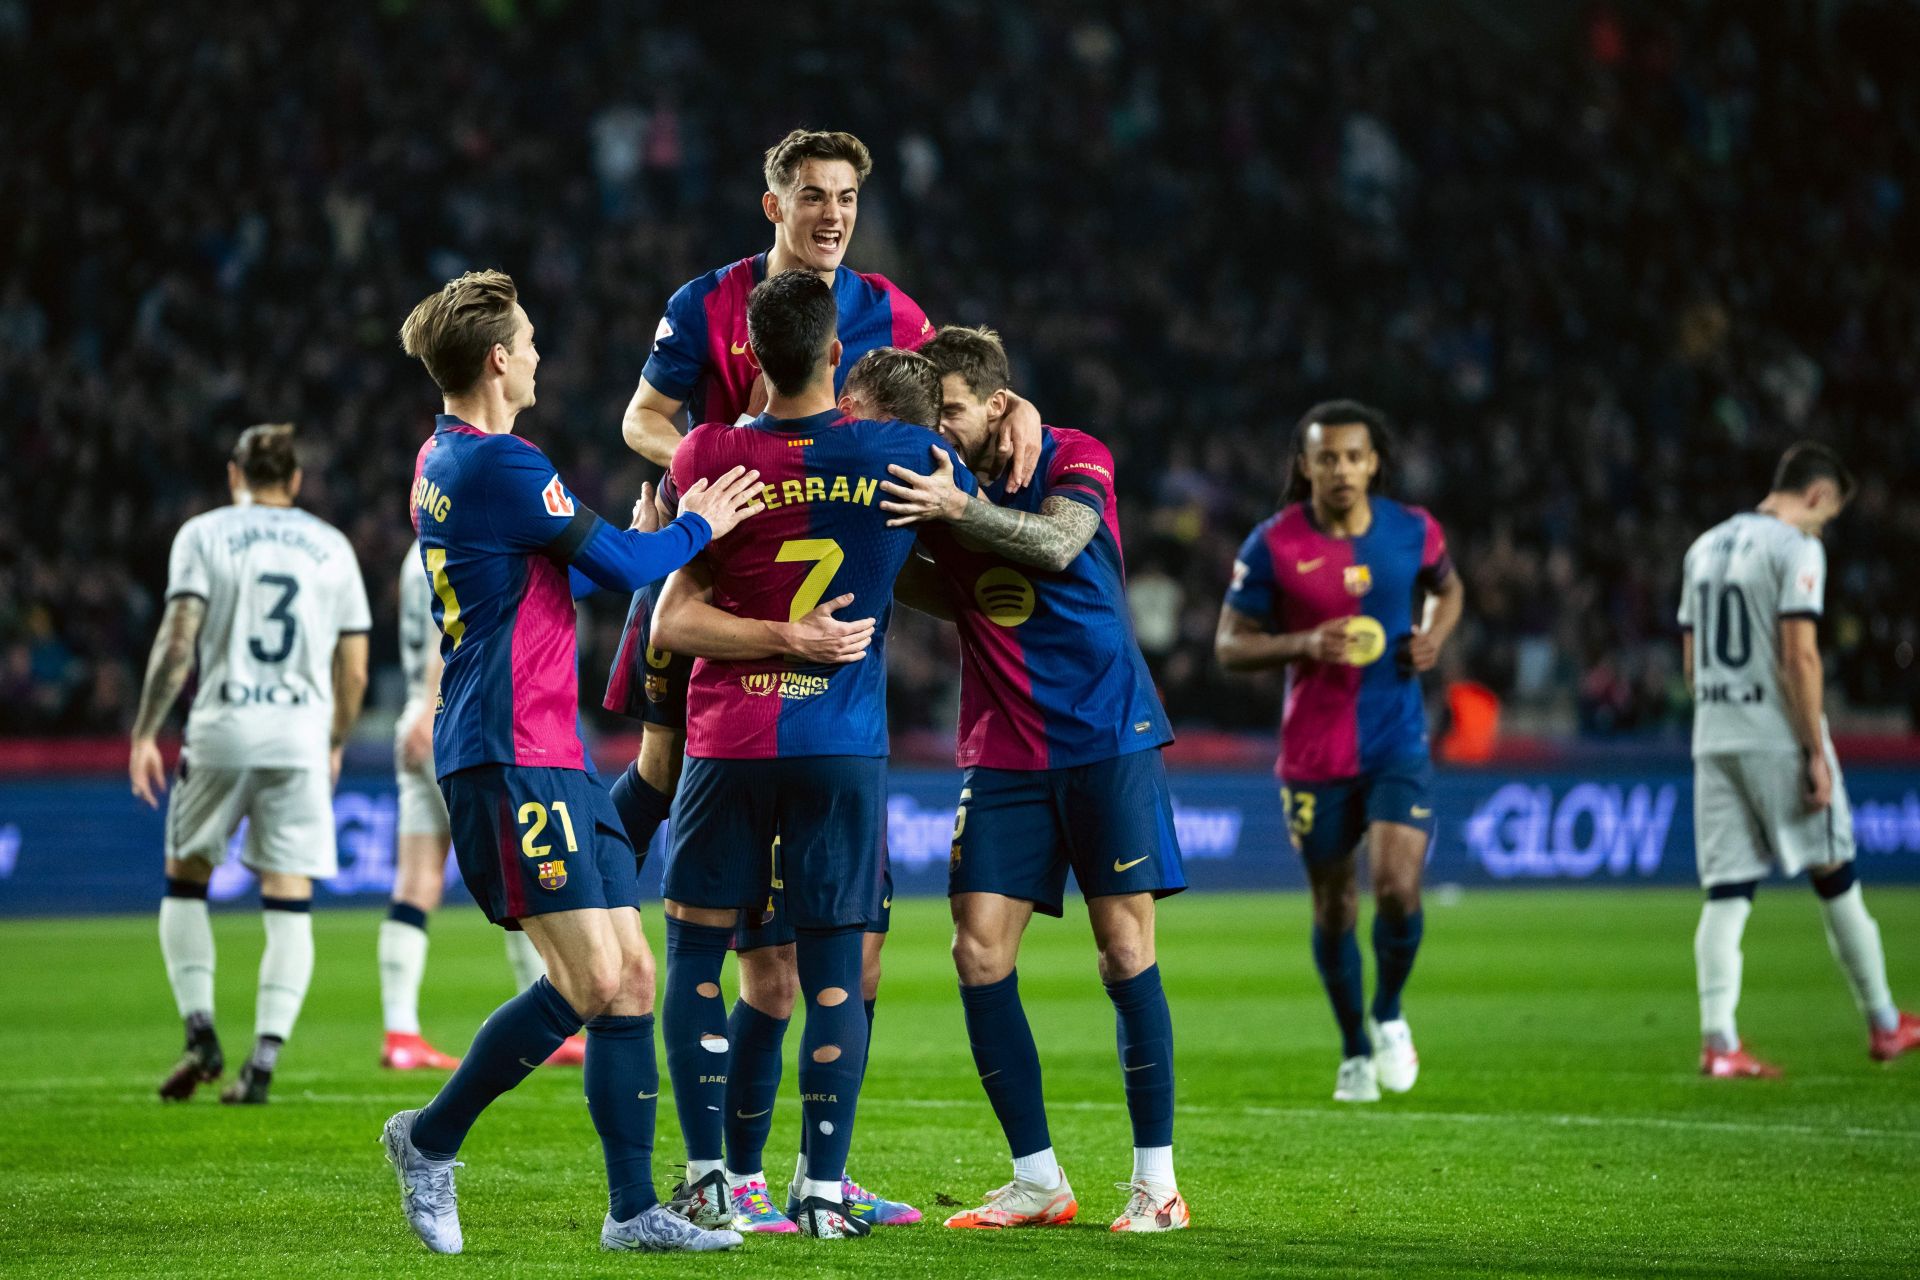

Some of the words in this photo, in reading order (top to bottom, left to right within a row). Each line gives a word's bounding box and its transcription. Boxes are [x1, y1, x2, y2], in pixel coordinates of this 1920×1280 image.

[248, 572, 299, 663] 3
[774, 538, 845, 625] 7
[1698, 580, 1752, 669] 10
[777, 682, 826, 697] ACN
[517, 801, 578, 858] 21
[1474, 782, 1678, 877] GLOW
